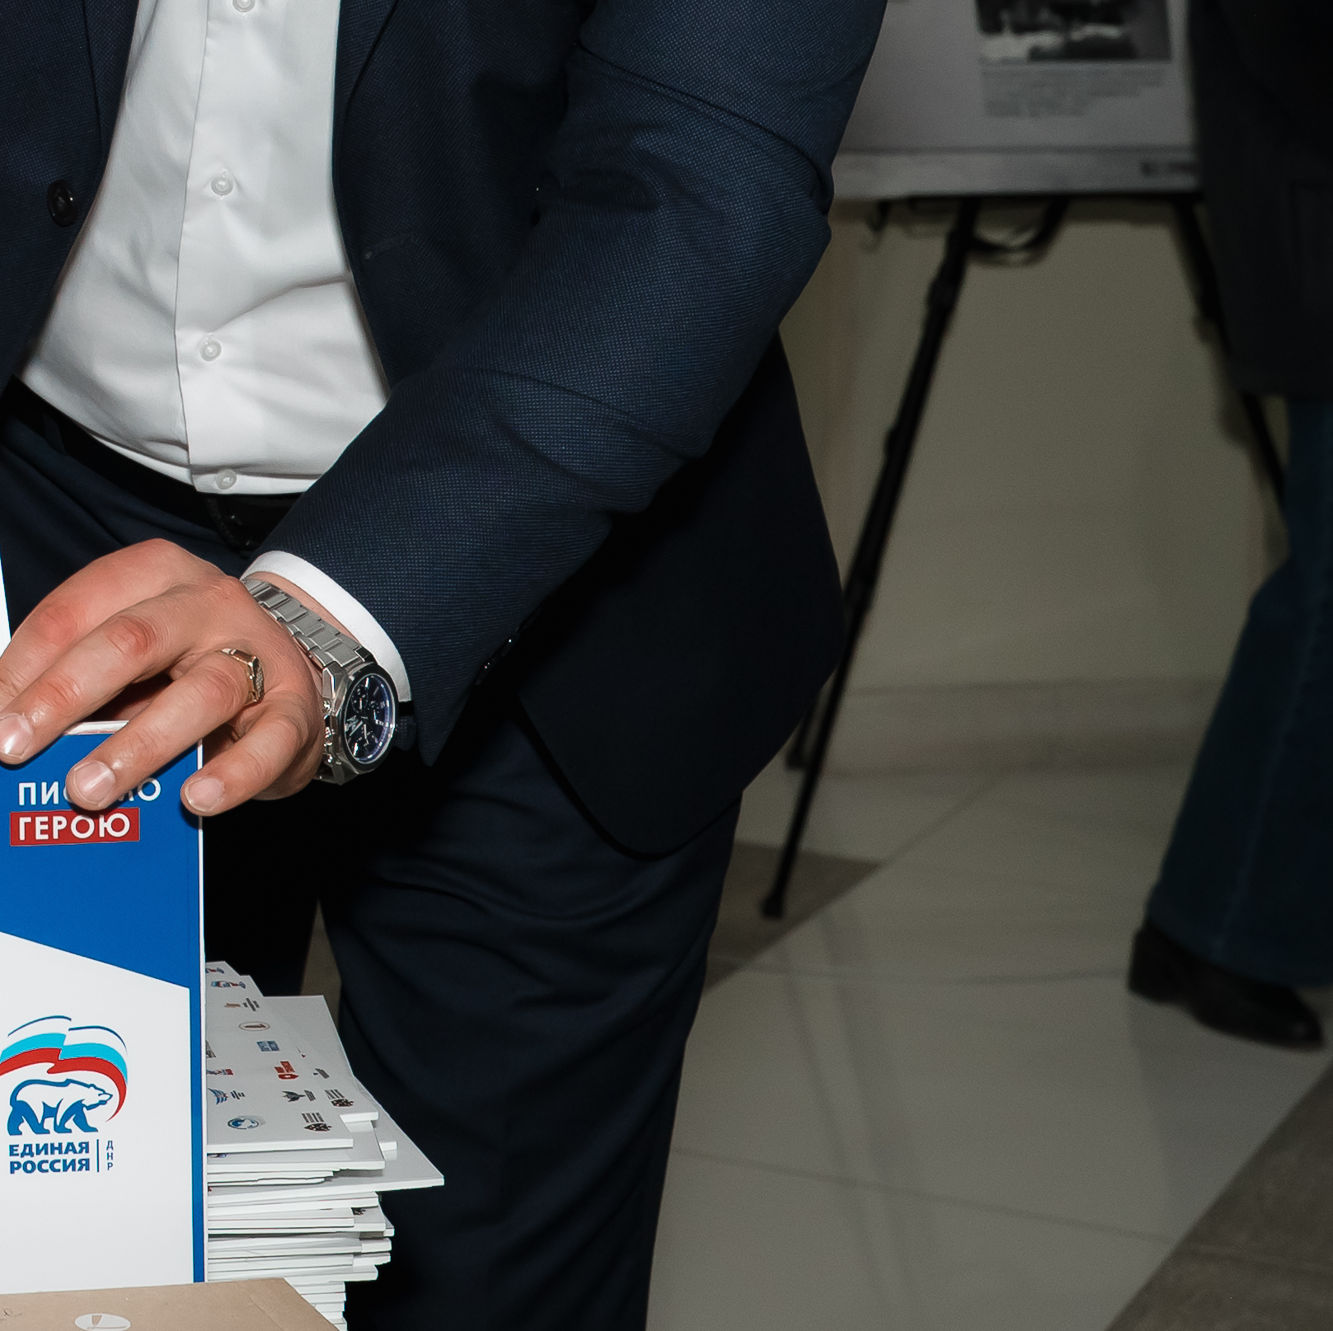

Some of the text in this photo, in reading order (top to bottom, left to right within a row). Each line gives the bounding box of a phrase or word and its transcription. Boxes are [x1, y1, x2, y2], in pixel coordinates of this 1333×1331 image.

[18, 812, 131, 842] ГЕРОЮ
[8, 1141, 90, 1159] ЕДИНАЯ
[105, 1139, 114, 1172] ДНР
[8, 1158, 91, 1176] РОССИЯ
